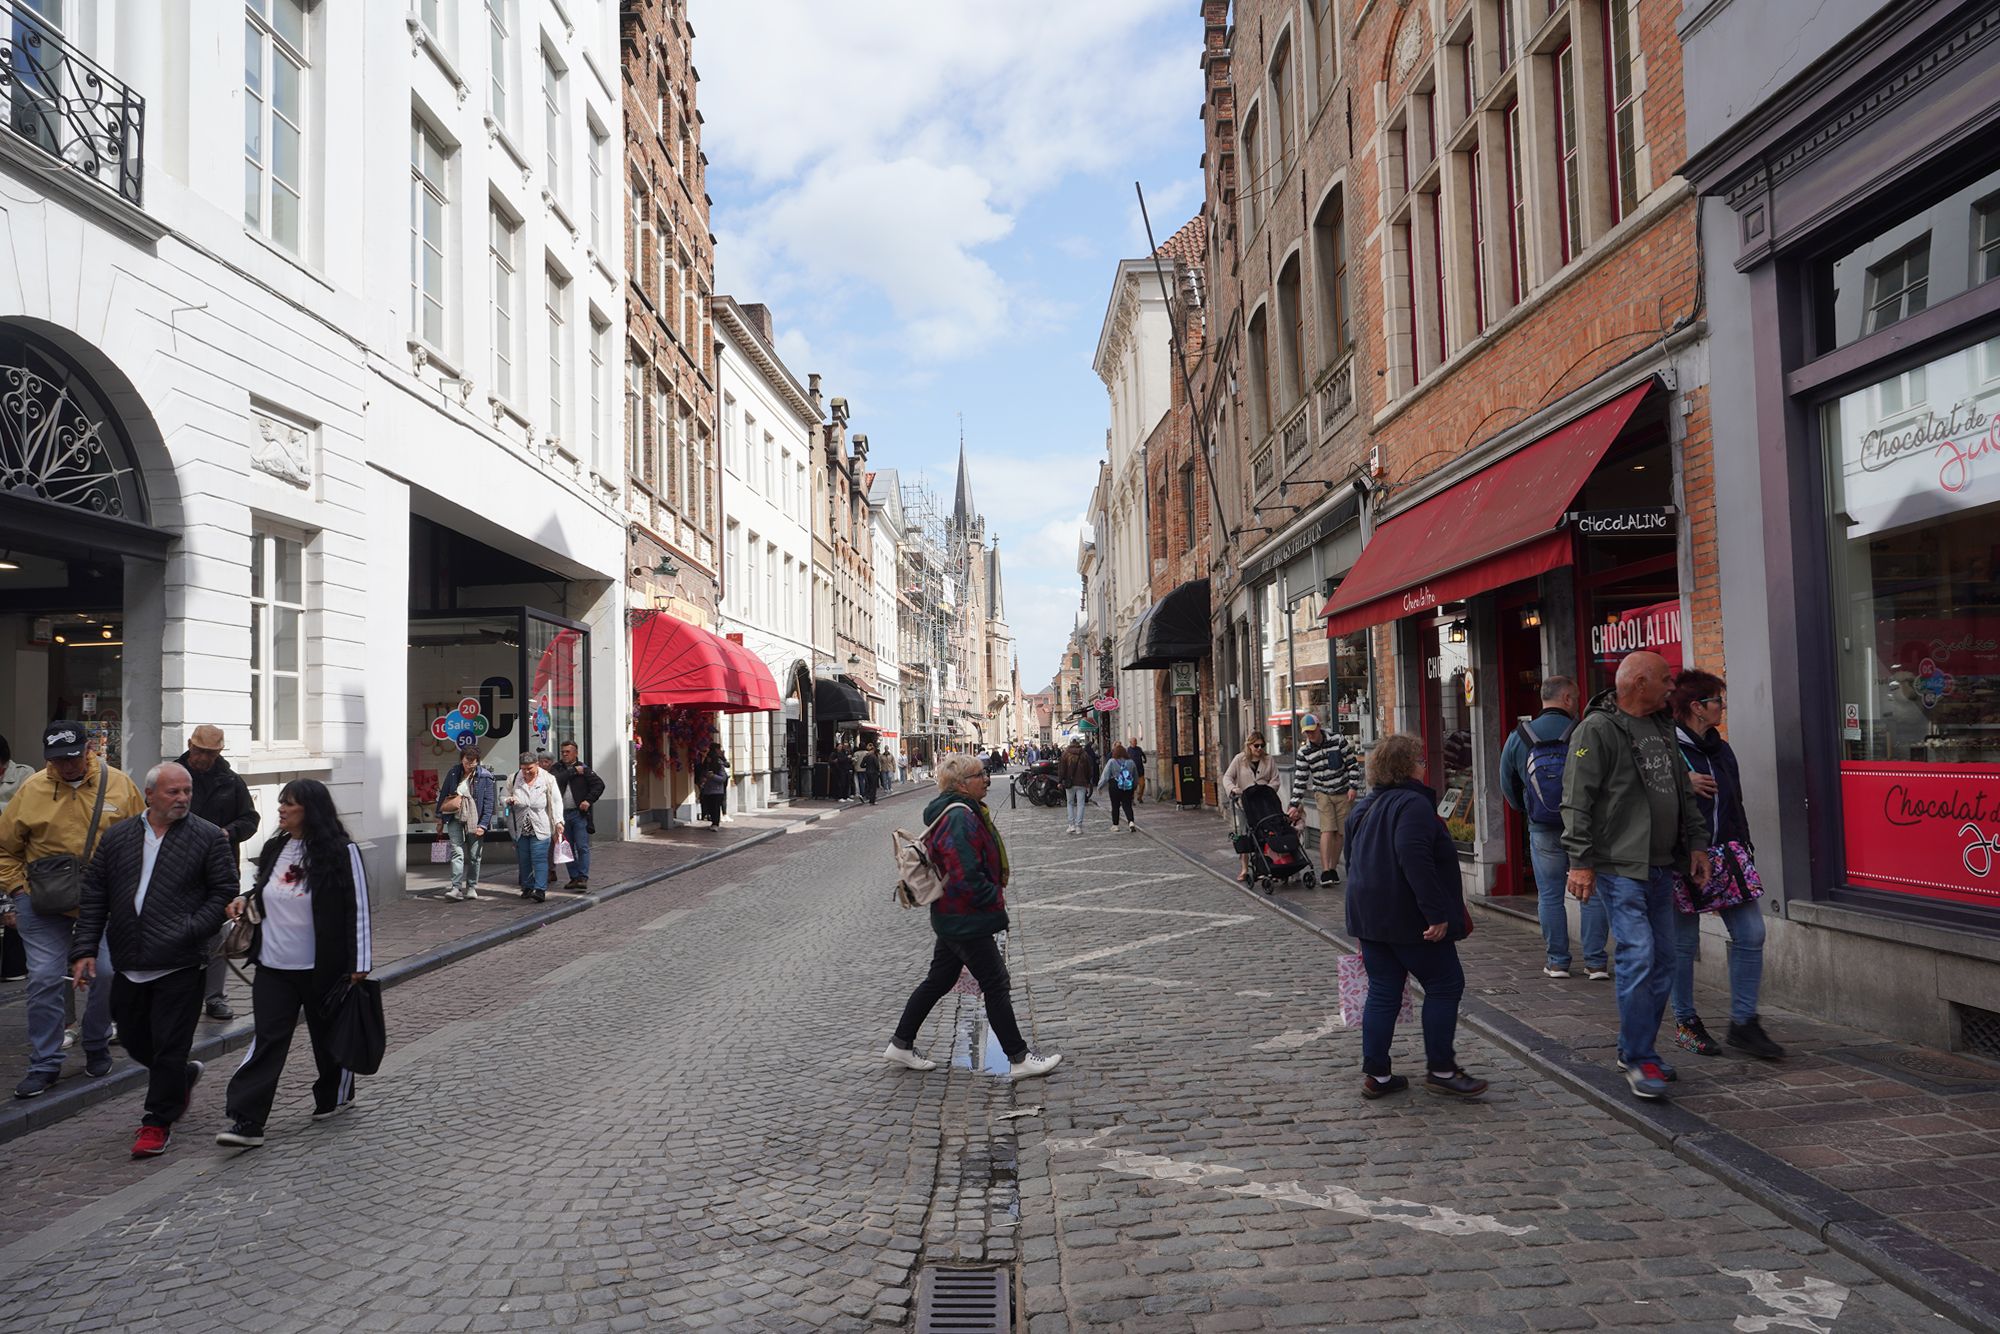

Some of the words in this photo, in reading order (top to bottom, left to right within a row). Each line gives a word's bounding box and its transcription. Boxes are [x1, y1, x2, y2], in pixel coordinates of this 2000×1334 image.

[1861, 403, 1961, 472] Chocolat
[1965, 408, 1987, 431] de
[462, 704, 476, 714] 20
[447, 720, 470, 730] Sale
[472, 721, 483, 730] %
[459, 735, 473, 745] 50
[1884, 784, 1987, 826] Chocolat
